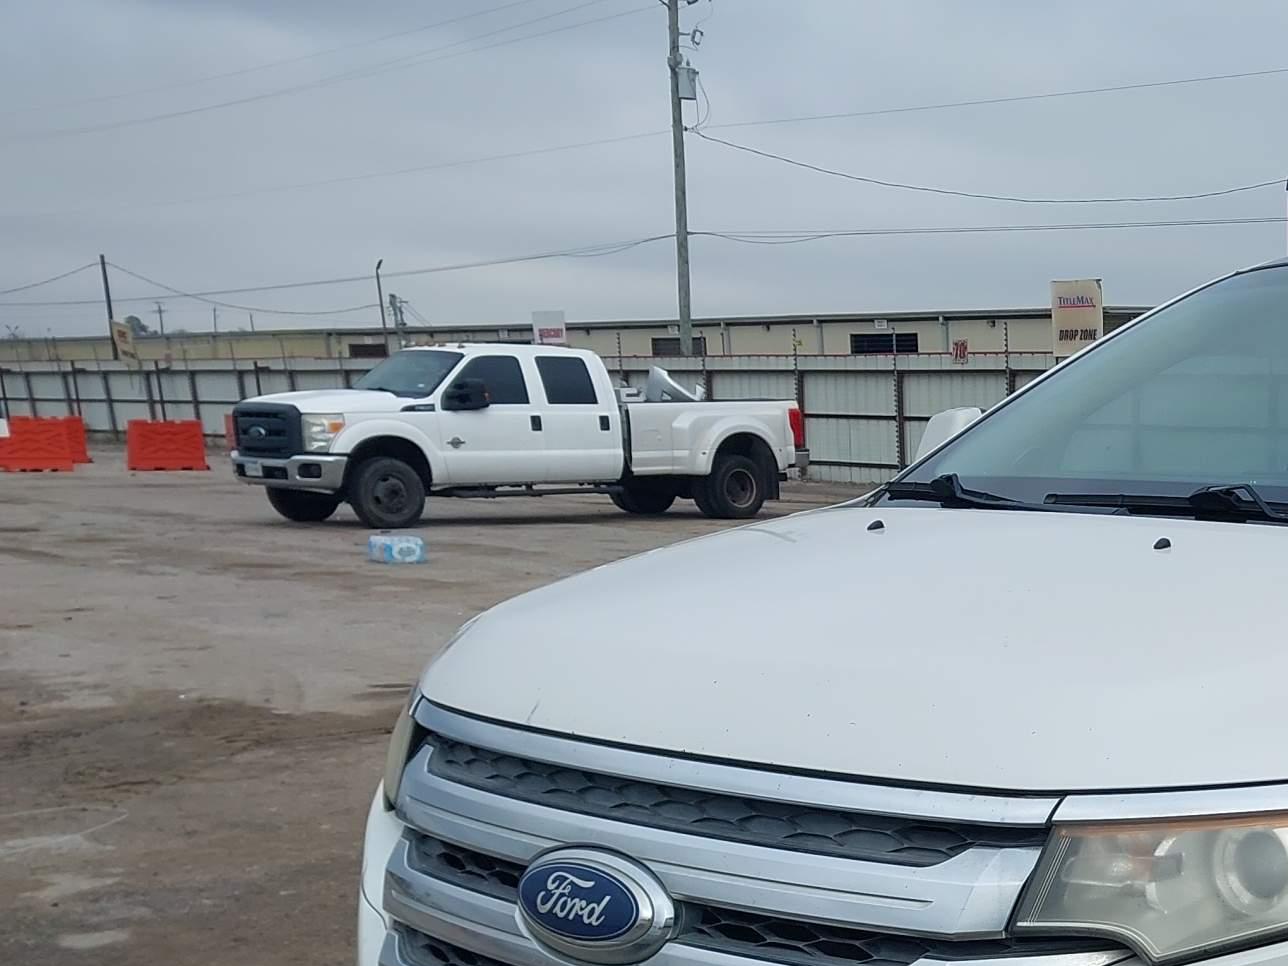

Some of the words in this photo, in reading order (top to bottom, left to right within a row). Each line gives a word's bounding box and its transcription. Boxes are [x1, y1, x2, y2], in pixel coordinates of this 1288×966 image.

[1059, 329, 1078, 341] DROP
[1080, 328, 1097, 341] ZONE
[536, 871, 612, 927] Ford
